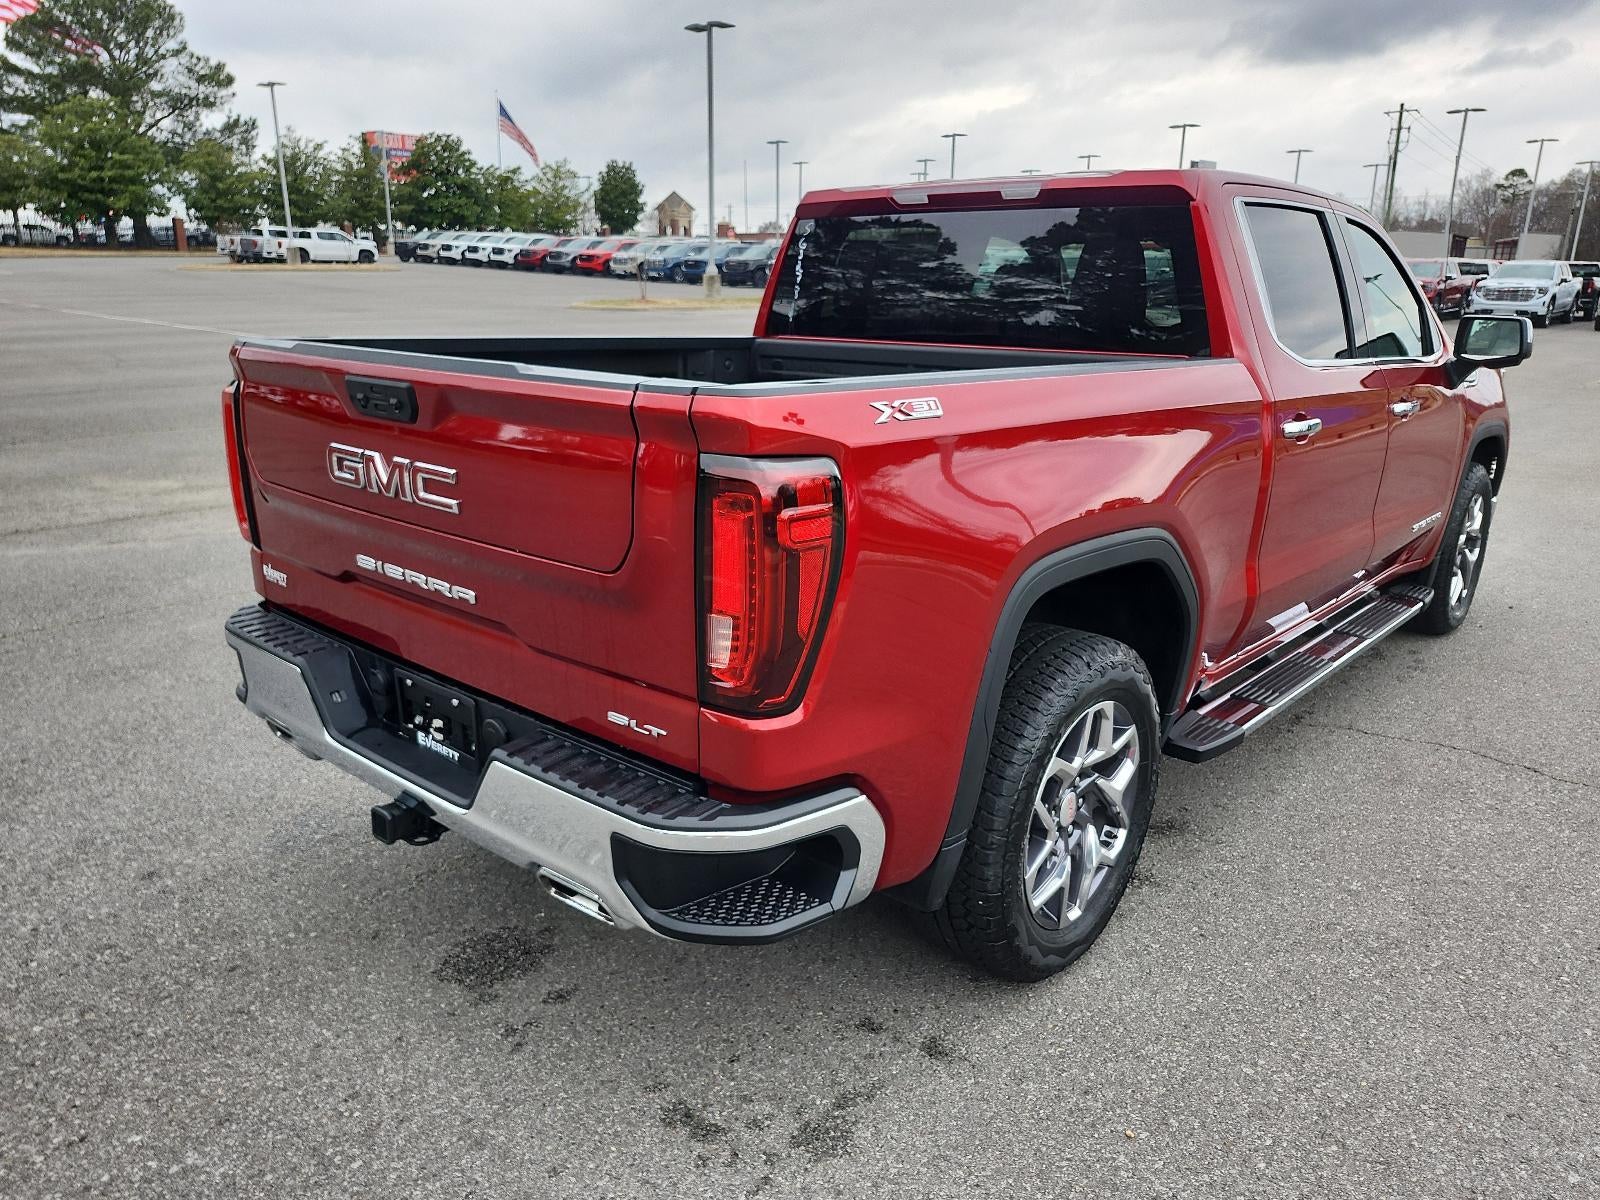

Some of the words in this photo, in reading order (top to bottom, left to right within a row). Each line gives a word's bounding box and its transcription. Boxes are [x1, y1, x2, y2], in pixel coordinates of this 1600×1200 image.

[868, 397, 944, 425] X31
[326, 442, 462, 515] GMC
[356, 553, 477, 605] SIERRA
[607, 711, 668, 738] SLT
[416, 731, 460, 761] EVERETT
